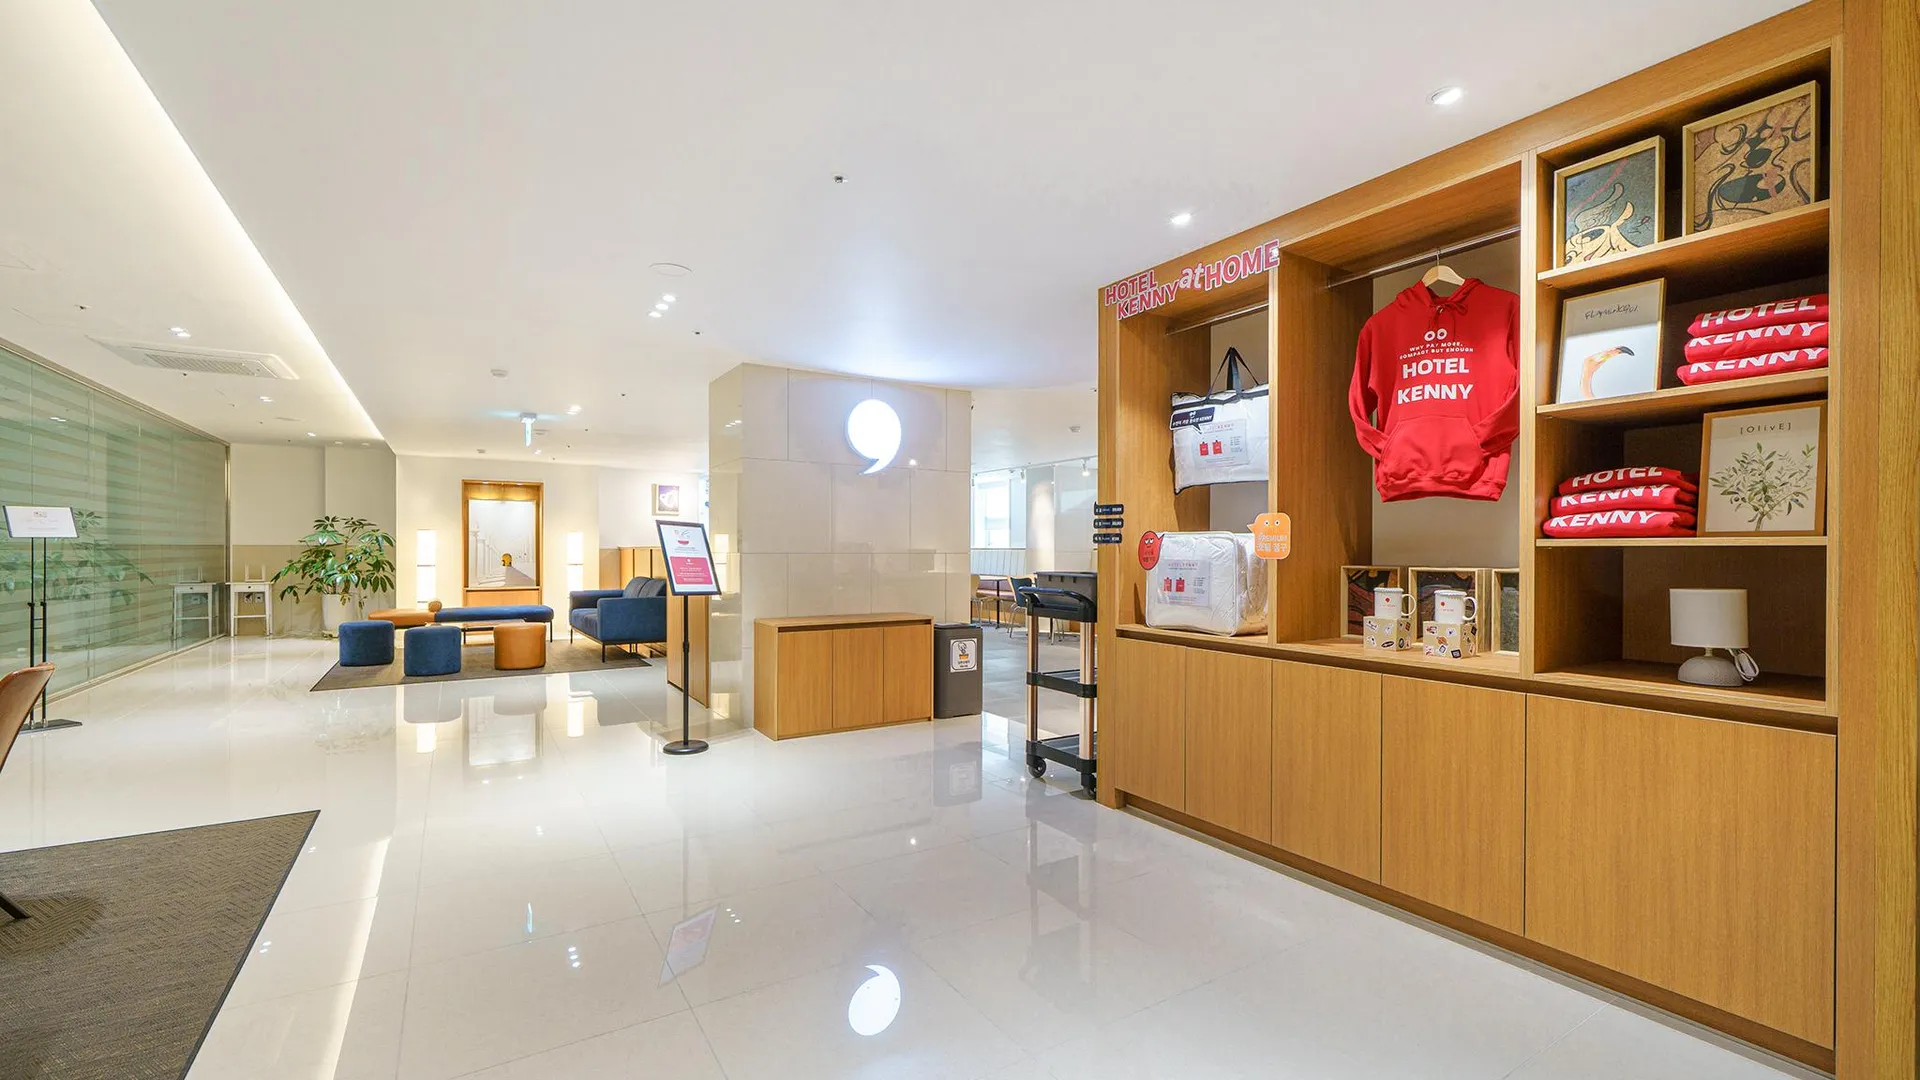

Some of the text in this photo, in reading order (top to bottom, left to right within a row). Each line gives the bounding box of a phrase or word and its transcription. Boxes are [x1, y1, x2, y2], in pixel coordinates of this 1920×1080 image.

[1105, 270, 1158, 306] HOTEL
[1117, 239, 1280, 320] KENNY at HOME
[1701, 298, 1817, 328] HOTEL
[1688, 322, 1828, 348] KENNY
[1401, 357, 1470, 379] HOTEL
[1689, 347, 1828, 374] KENNY
[1397, 384, 1474, 405] KENNY
[1571, 466, 1663, 488] HOTEL
[1560, 484, 1670, 508] KENNY
[1549, 510, 1661, 528] KENNY
